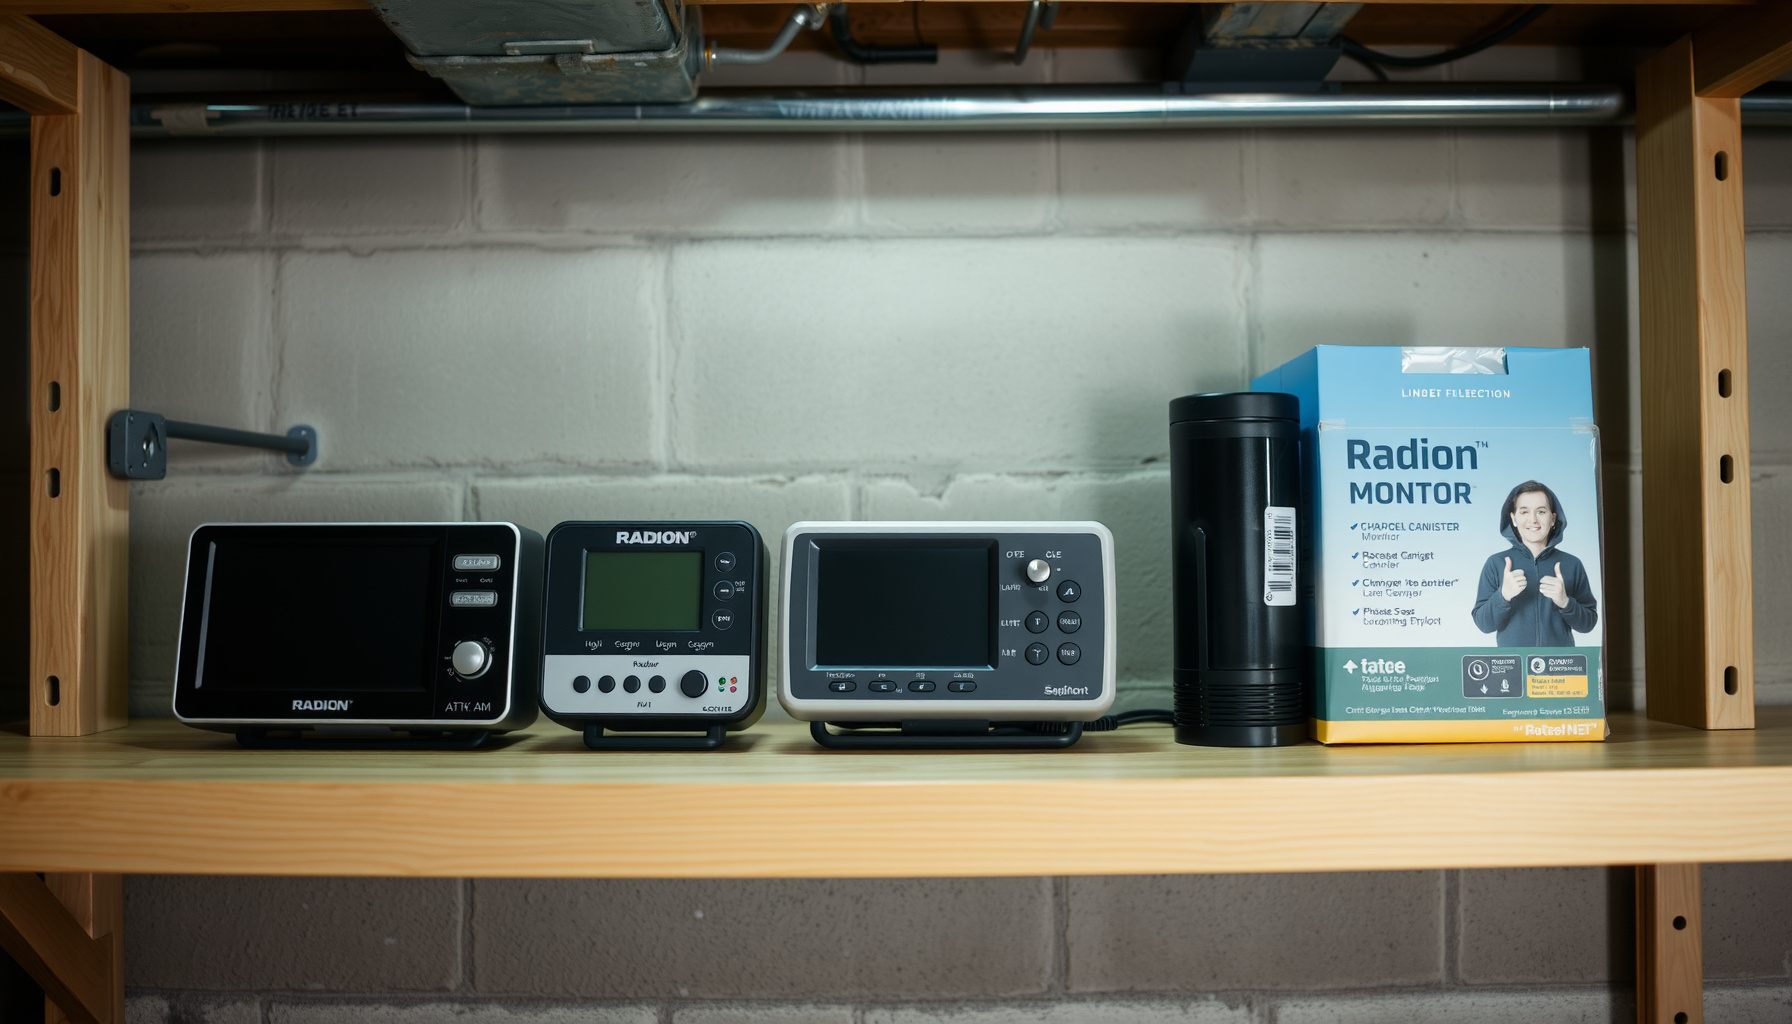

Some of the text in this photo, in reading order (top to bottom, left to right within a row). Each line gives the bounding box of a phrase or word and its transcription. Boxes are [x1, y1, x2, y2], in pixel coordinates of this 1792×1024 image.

[1346, 438, 1478, 470] Radion
[1349, 481, 1472, 504] MONTOR
[616, 531, 690, 544] RADION
[292, 699, 349, 711] RADION
